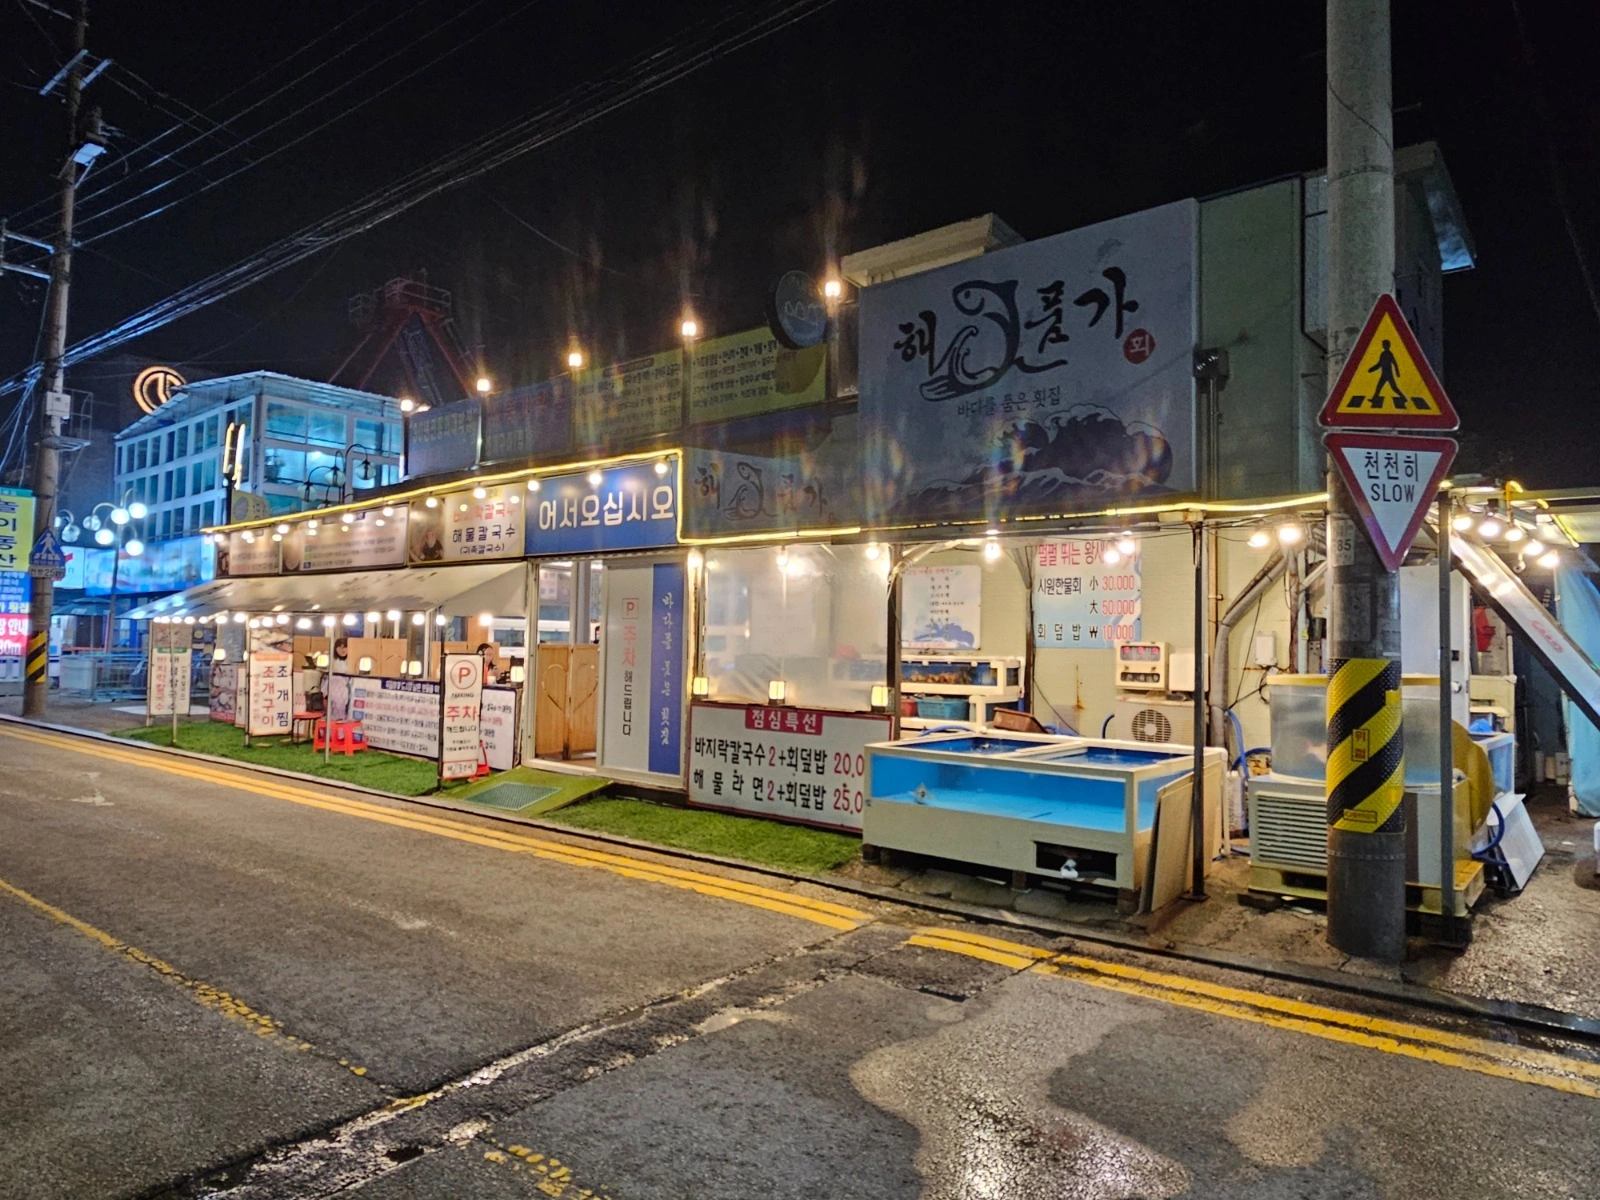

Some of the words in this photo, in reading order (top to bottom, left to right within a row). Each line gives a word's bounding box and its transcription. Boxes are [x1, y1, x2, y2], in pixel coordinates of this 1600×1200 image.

[957, 396, 995, 417] 바다를
[1001, 392, 1028, 413] 품은
[1033, 385, 1060, 408] 횟집
[1364, 451, 1419, 481] 천천히
[1371, 483, 1415, 503] SLOW
[539, 486, 674, 531] 어서오십시오
[453, 524, 516, 543] 해물칼국수
[1039, 543, 1057, 566] 펄펄
[1061, 542, 1080, 565] 뛰는
[1037, 577, 1082, 595] 시원한물회
[1089, 576, 1098, 591] 小
[1102, 575, 1135, 591] 30.000
[1089, 600, 1098, 615] 大
[1102, 600, 1135, 615] 50.000
[661, 592, 674, 650] 바다를
[1102, 625, 1135, 640] 10.000
[623, 626, 636, 667] 주차
[459, 667, 471, 684] P
[262, 666, 274, 727] 조개구이
[276, 665, 289, 727] 조개찜
[623, 670, 633, 736] 해드립니다
[446, 704, 478, 722] 주차
[752, 709, 817, 733] 점심특선
